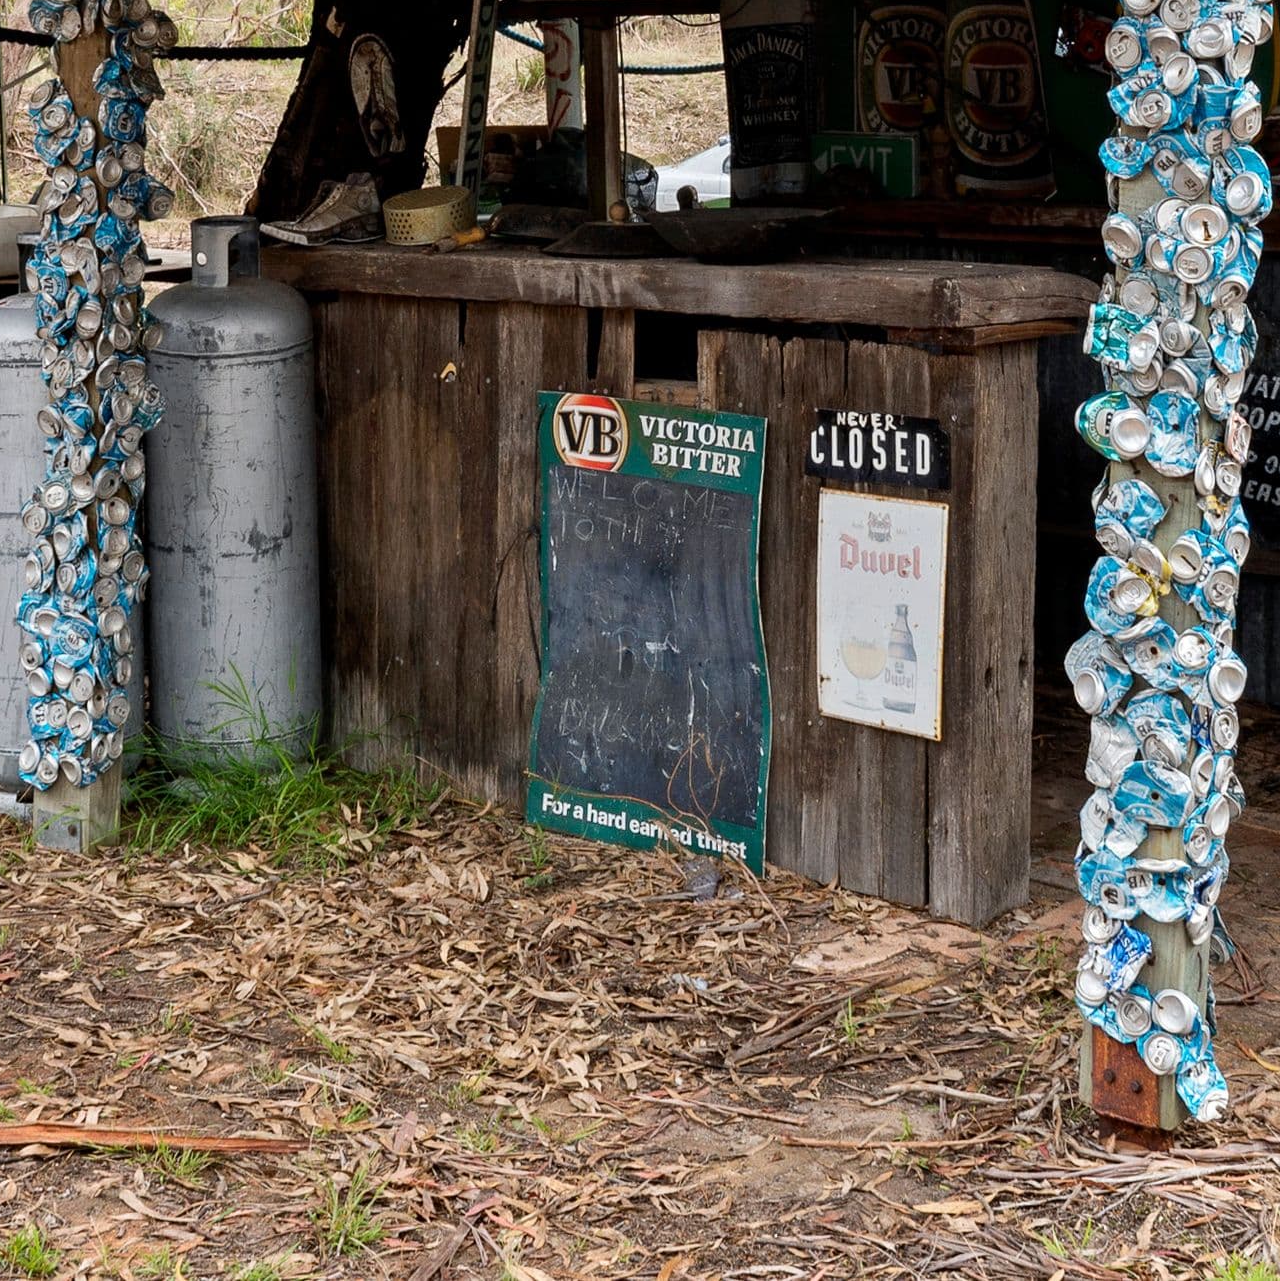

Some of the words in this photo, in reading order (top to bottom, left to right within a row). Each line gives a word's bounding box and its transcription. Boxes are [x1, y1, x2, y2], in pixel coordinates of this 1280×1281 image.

[950, 17, 1036, 67] VICTOR
[974, 68, 1018, 105] VB
[558, 410, 621, 457] VB
[639, 415, 756, 453] VICTORIA
[836, 411, 898, 431] NEVER
[652, 442, 742, 478] BITTER
[810, 425, 931, 476] CLOSED
[839, 533, 922, 582] Duvel
[884, 668, 915, 692] Duvel
[542, 792, 571, 818] For
[572, 804, 584, 820] a
[586, 802, 627, 831] hard
[629, 819, 693, 847] earned
[696, 831, 748, 861] thirst
